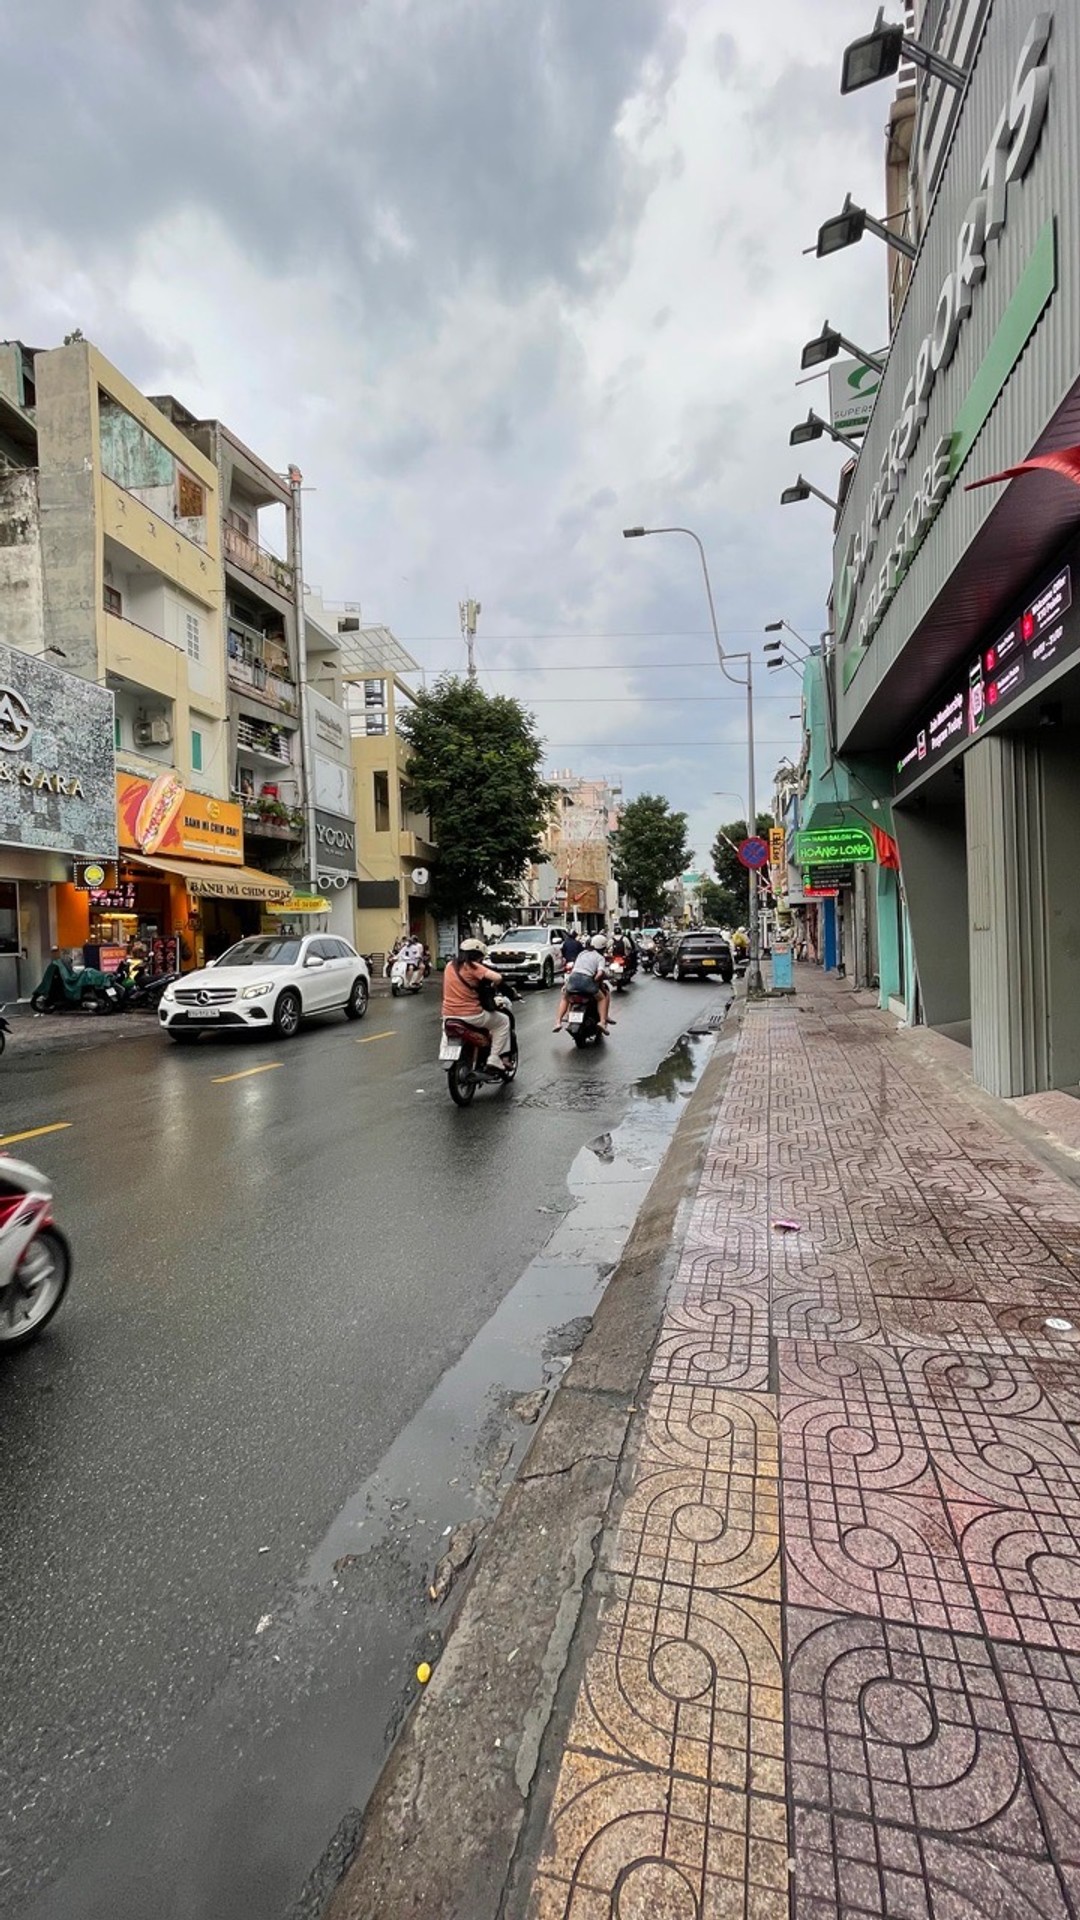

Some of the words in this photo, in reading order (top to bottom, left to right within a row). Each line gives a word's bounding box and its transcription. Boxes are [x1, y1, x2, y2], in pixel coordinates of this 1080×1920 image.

[853, 12, 1052, 586] SUPERSPORTS
[896, 432, 952, 573] STORE
[22, 766, 85, 800] SARA
[316, 823, 355, 850] YOON
[840, 844, 870, 855] LONG
[241, 887, 267, 897] CHIM
